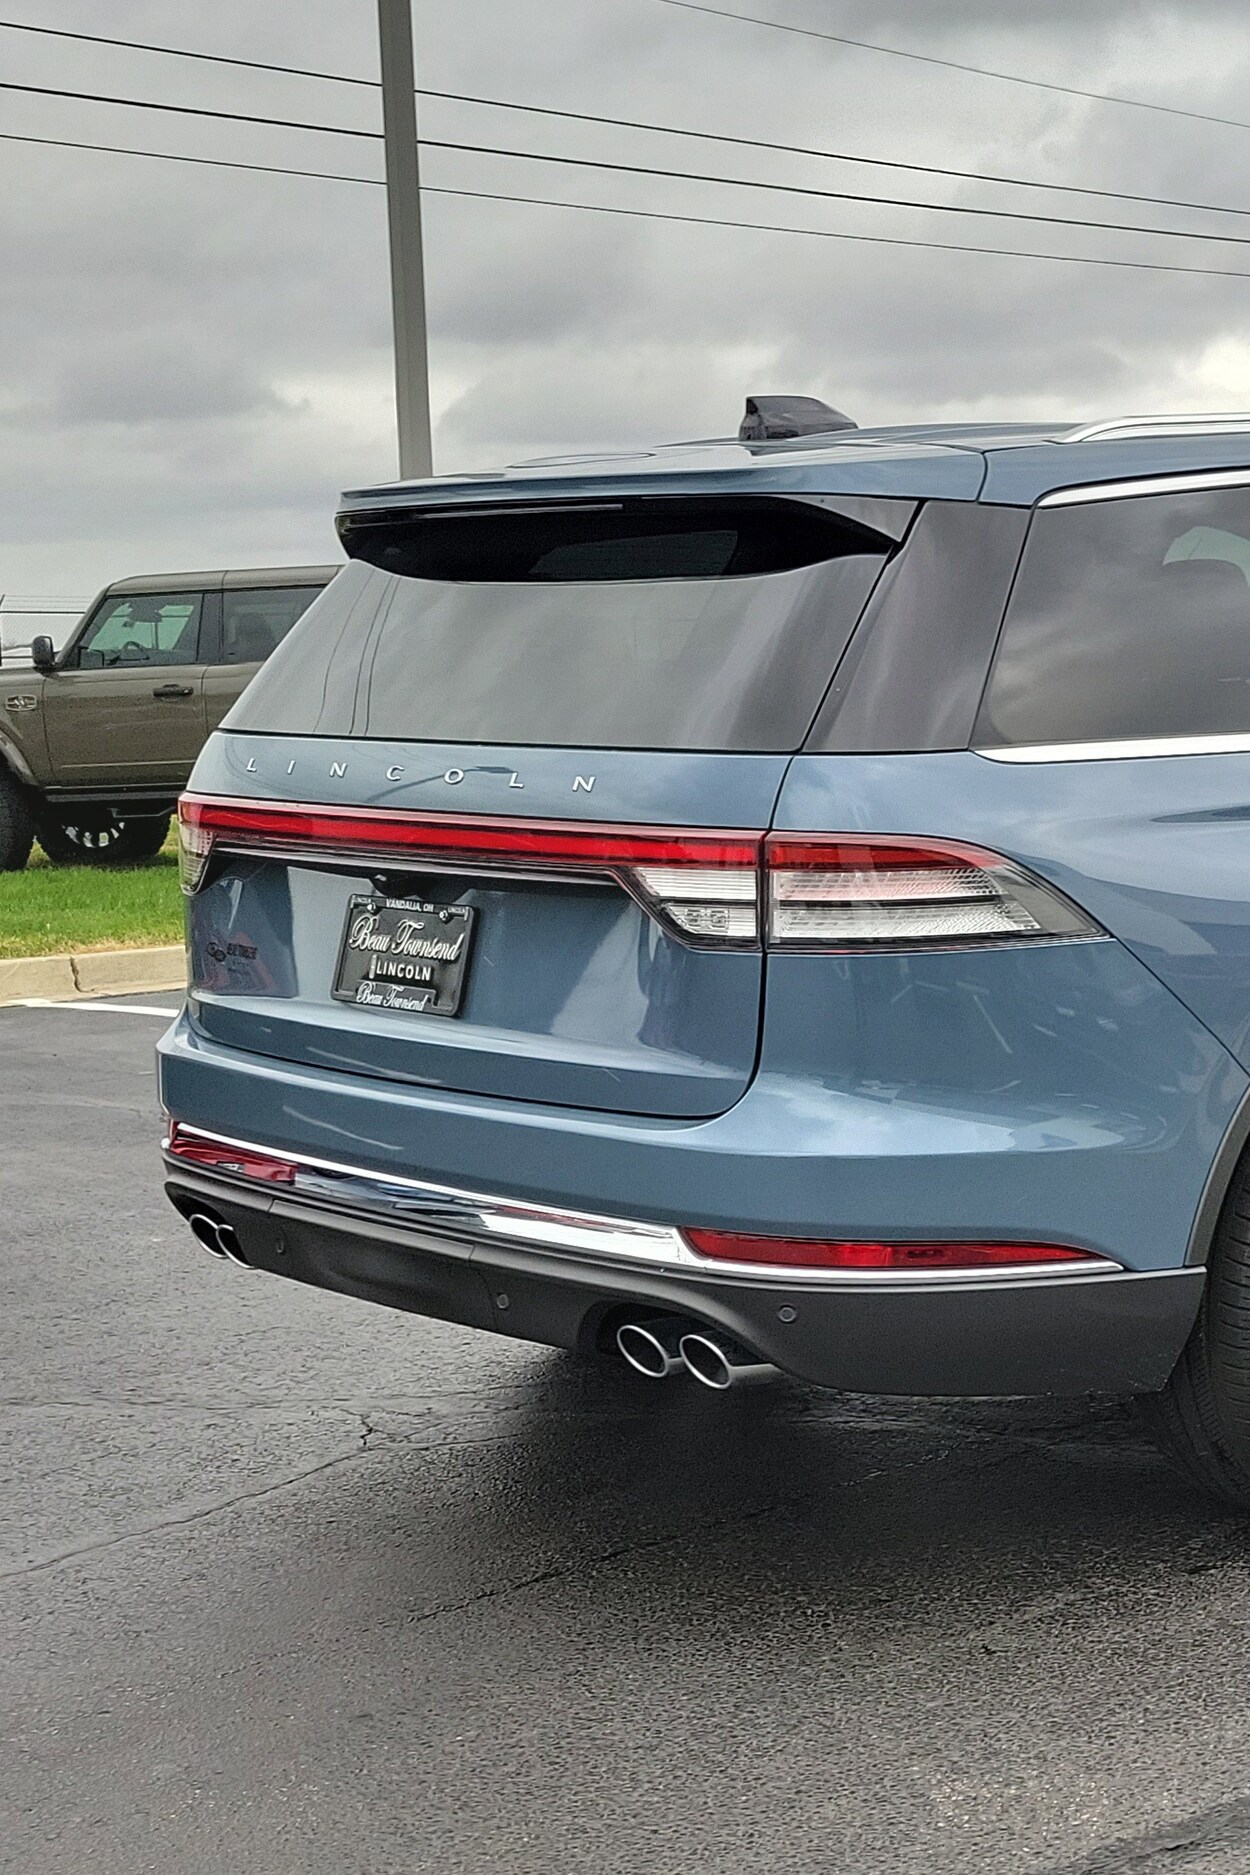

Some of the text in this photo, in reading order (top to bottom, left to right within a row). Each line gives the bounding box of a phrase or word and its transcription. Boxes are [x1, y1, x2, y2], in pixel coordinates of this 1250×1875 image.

[246, 757, 596, 794] LINCOLN
[386, 899, 435, 912] VANDALIA, OH
[349, 914, 465, 961] Beau Townsend
[376, 960, 432, 981] LINCOLN
[356, 982, 429, 1012] Beau Townsend
